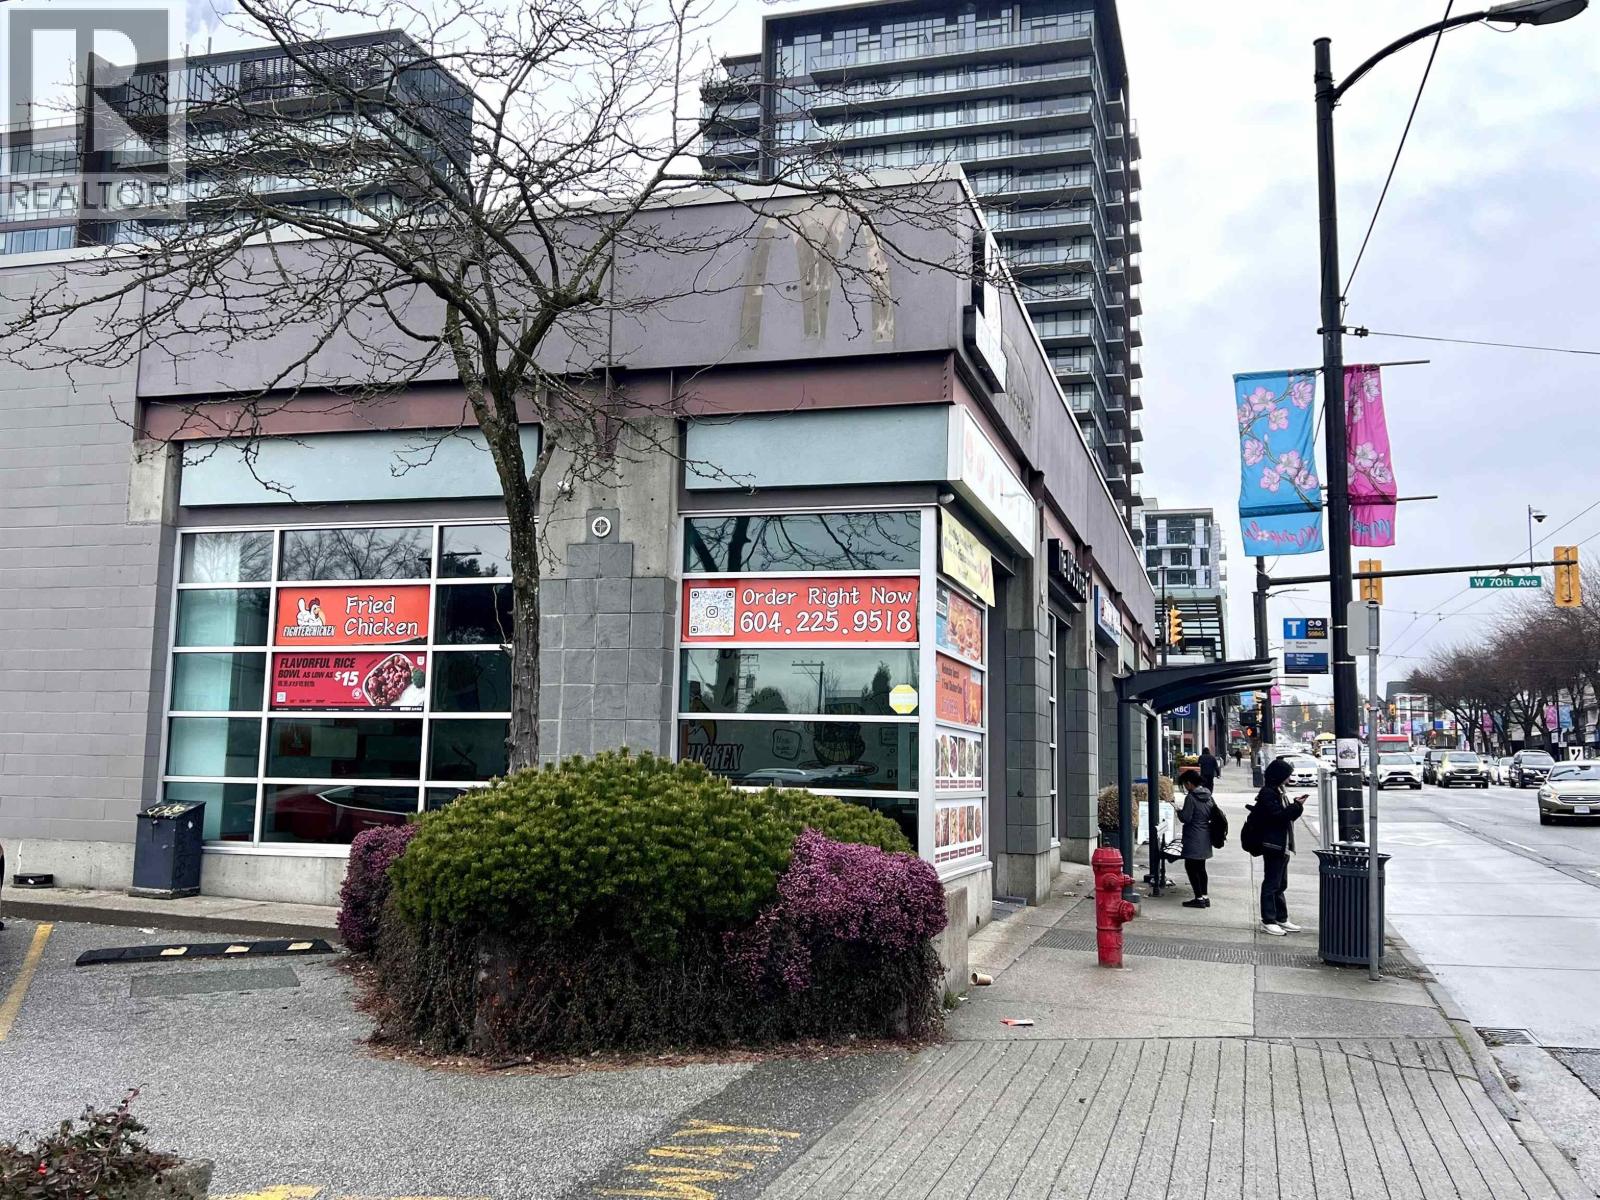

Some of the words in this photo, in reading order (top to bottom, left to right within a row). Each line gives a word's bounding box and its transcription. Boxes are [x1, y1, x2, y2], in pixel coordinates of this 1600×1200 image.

[1474, 578, 1485, 587] W
[1489, 578, 1514, 587] 70th
[1518, 578, 1538, 587] Ave
[345, 595, 396, 614] Fried
[742, 588, 798, 606] Order
[808, 587, 860, 608] Right
[871, 586, 912, 604] Now
[344, 617, 418, 636] Chicken
[739, 609, 912, 635] 604.225.9518
[1287, 620, 1301, 637] T
[280, 657, 330, 669] FLAVORFUL
[333, 657, 356, 669] RICE
[278, 669, 300, 679] BOWL
[303, 671, 311, 679] AS
[326, 671, 334, 679] AS
[334, 670, 360, 687] $15
